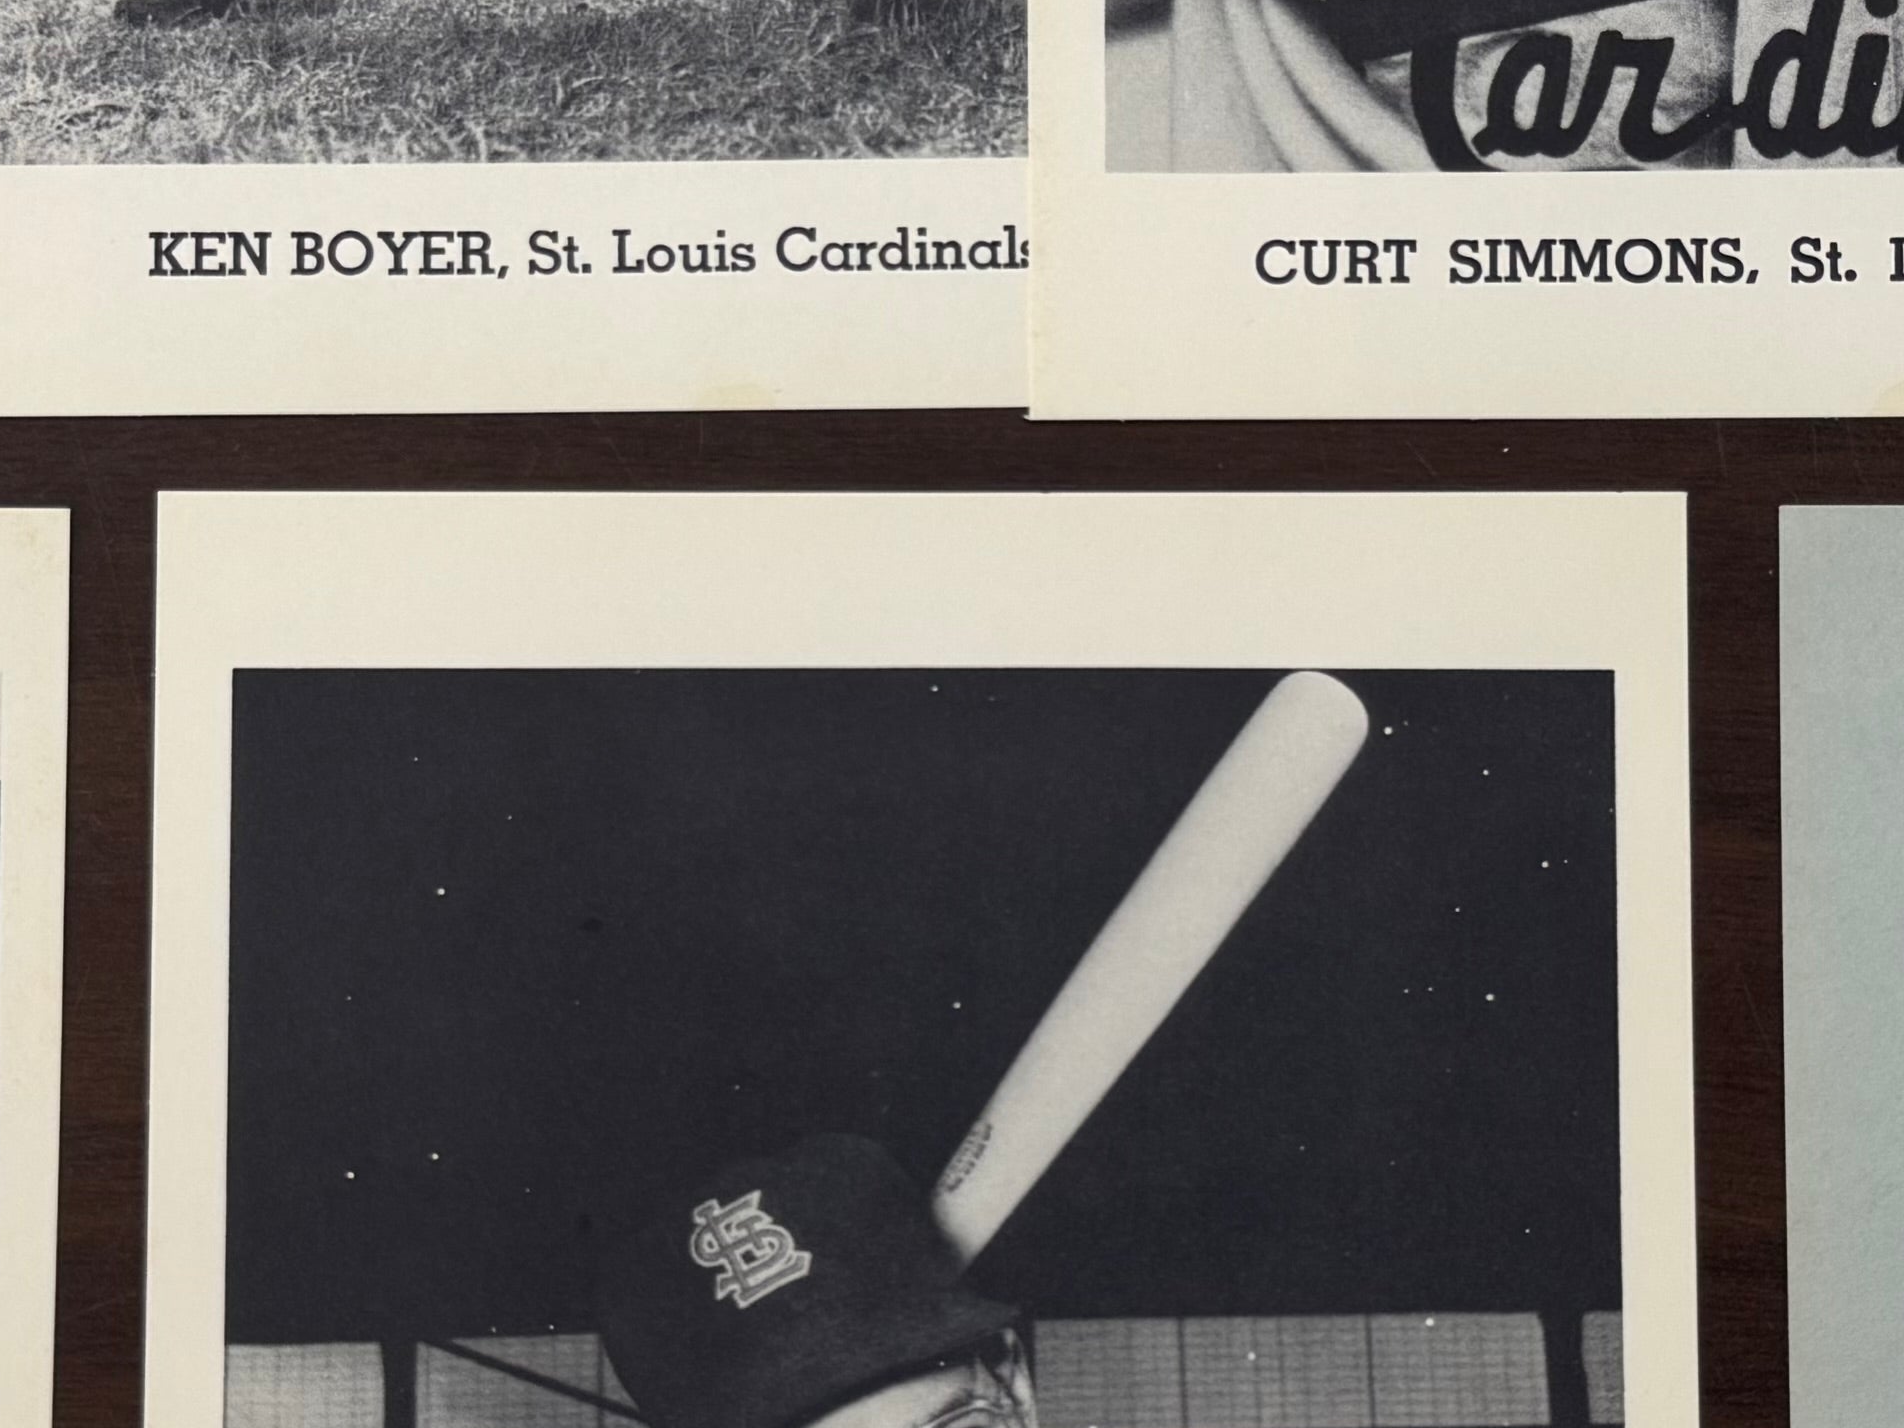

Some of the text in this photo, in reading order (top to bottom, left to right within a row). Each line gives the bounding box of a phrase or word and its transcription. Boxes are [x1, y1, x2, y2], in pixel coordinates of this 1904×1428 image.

[147, 230, 273, 278] KEN
[289, 229, 510, 280] BOYER,
[527, 229, 593, 276] St.
[611, 228, 757, 275] Louis
[1254, 238, 1418, 286] CURT
[1448, 236, 1760, 285] SIMMONS,
[1790, 235, 1858, 284] St.
